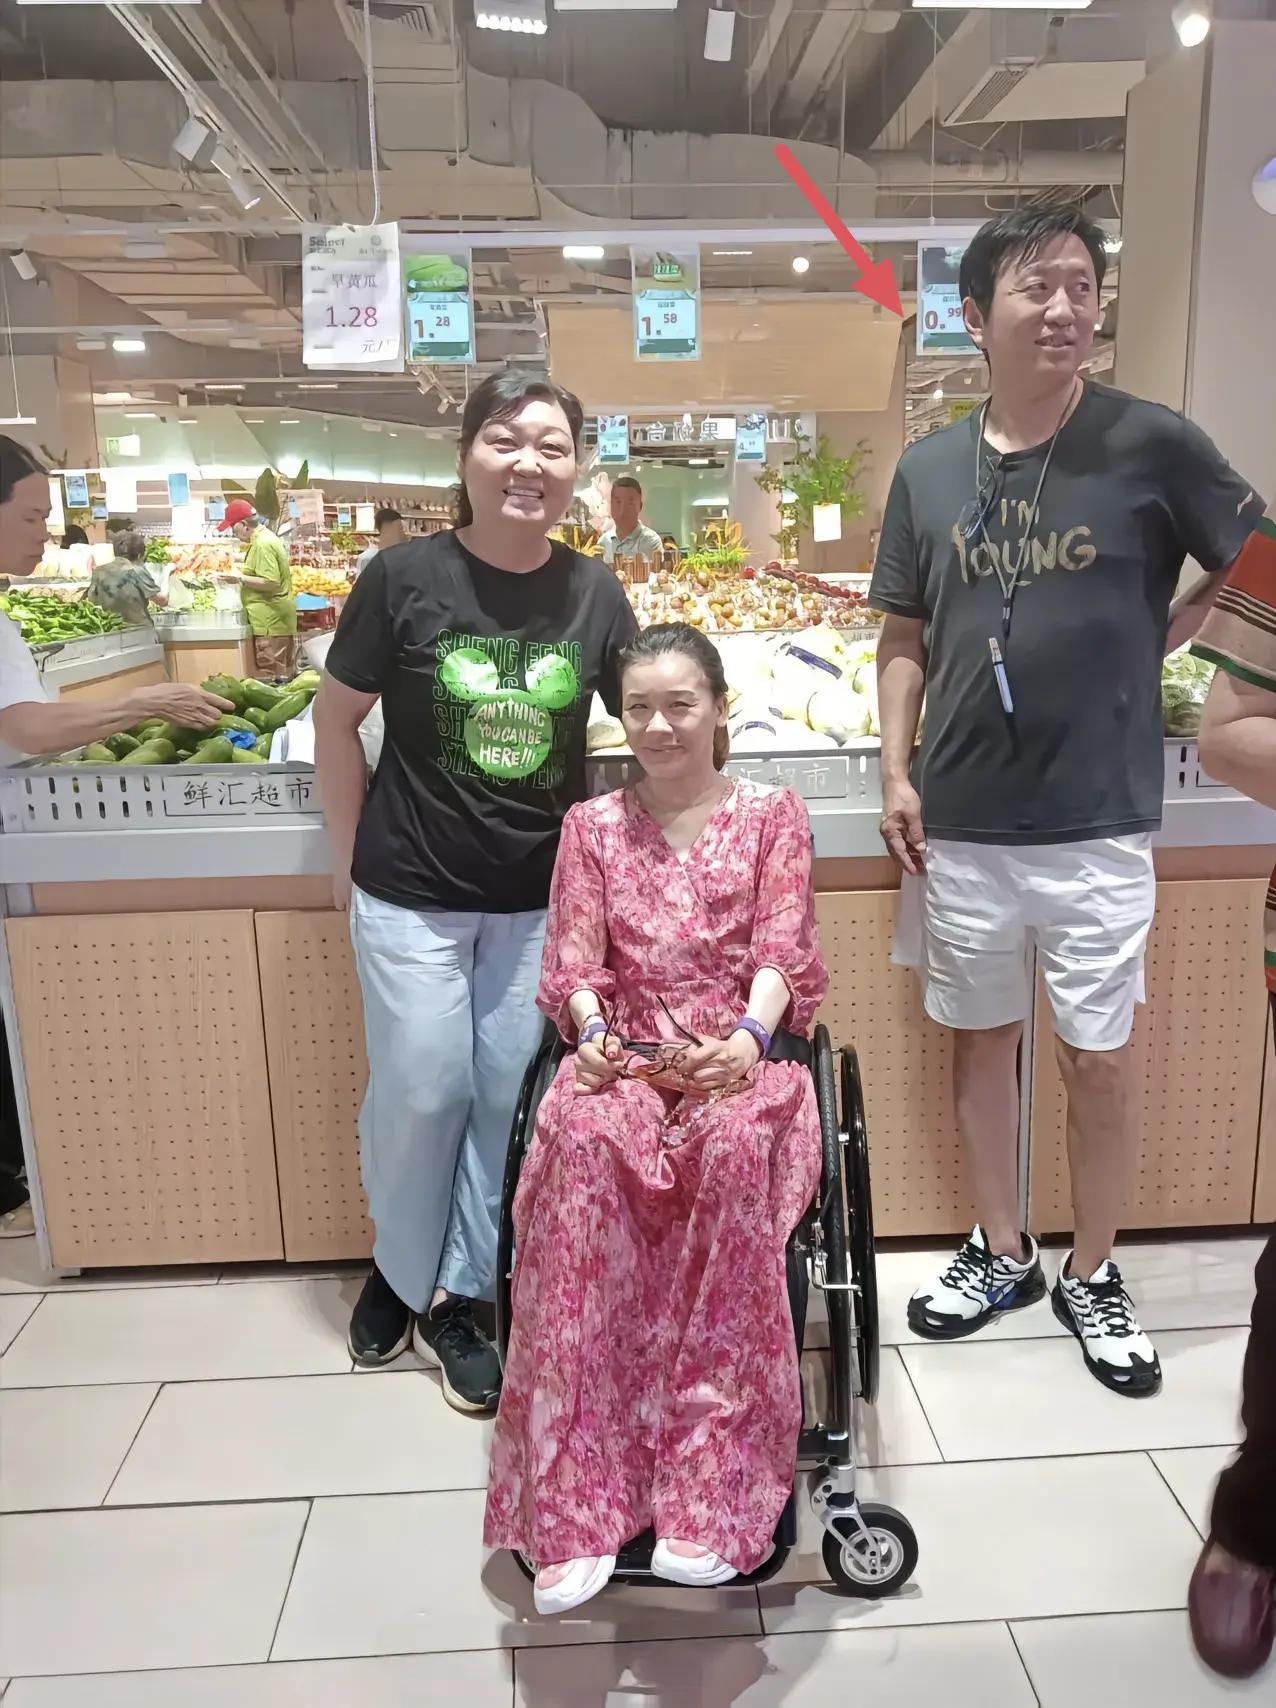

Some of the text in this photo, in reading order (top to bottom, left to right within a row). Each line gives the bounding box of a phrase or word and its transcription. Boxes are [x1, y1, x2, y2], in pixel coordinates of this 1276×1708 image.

[326, 306, 378, 328] 1.28
[1000, 498, 1040, 527] I'M
[952, 525, 1098, 584] YOUNG
[474, 697, 547, 728] ANYTHING
[479, 743, 536, 769] HERE!!!
[183, 777, 314, 809] 鲜汇超市
